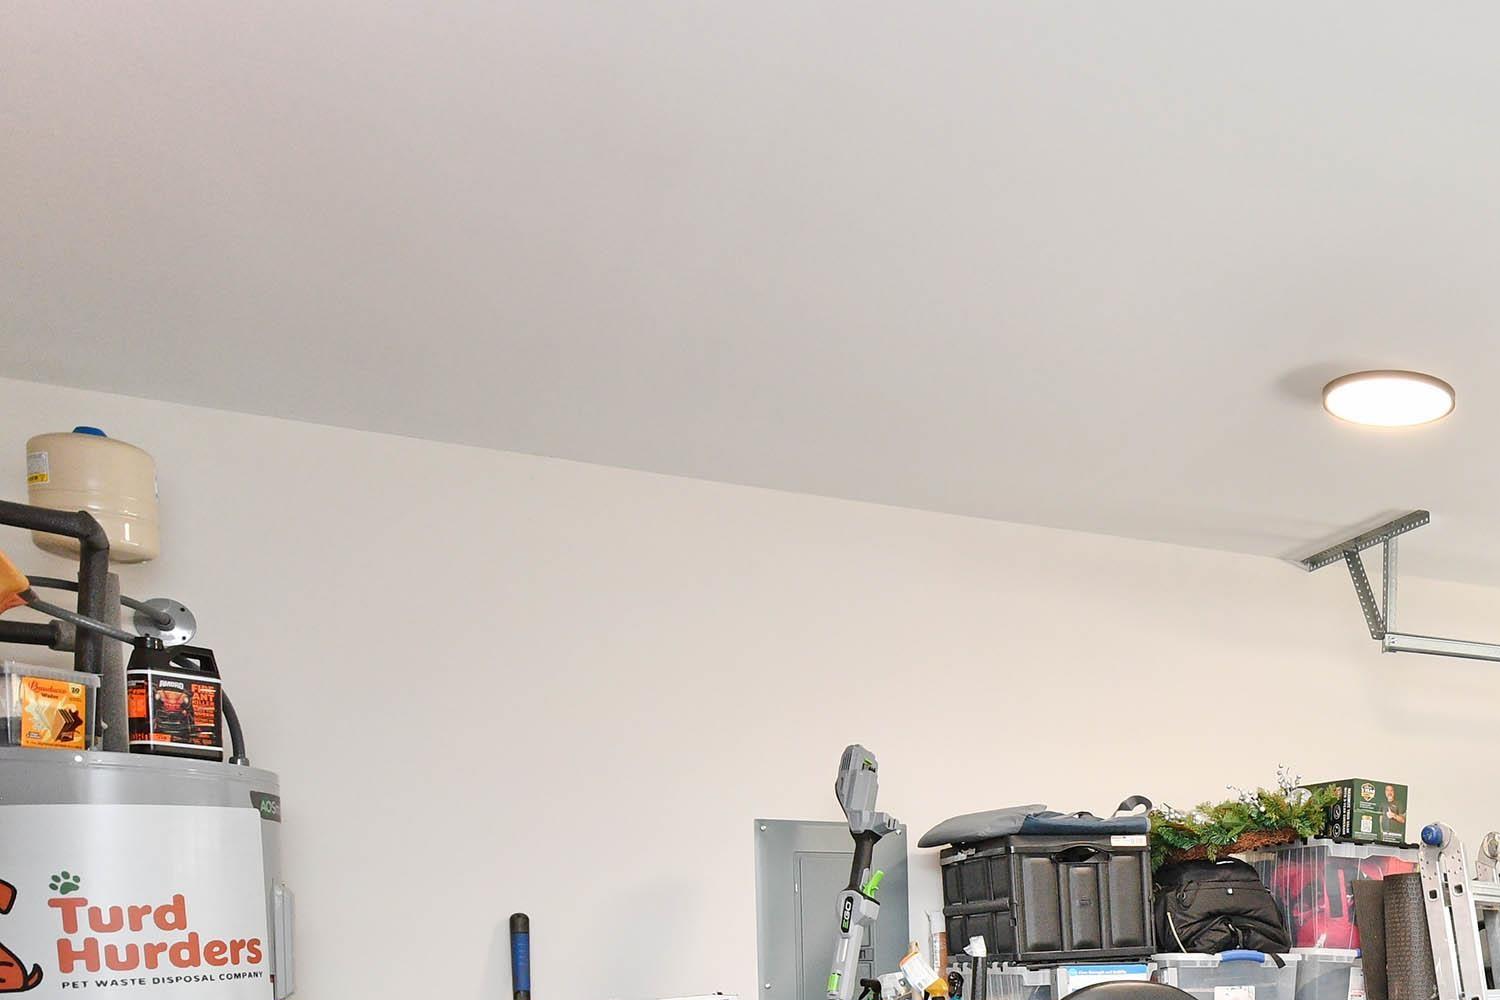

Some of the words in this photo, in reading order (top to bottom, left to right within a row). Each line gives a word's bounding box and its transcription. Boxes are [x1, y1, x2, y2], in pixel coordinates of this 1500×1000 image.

[48, 894, 187, 934] Turd
[842, 900, 851, 929] EGO
[57, 932, 262, 973] Hurders
[61, 981, 88, 989] PET
[96, 977, 146, 988] WASTE
[152, 974, 216, 985] DISPOSAL
[219, 971, 263, 981] COMPANY
